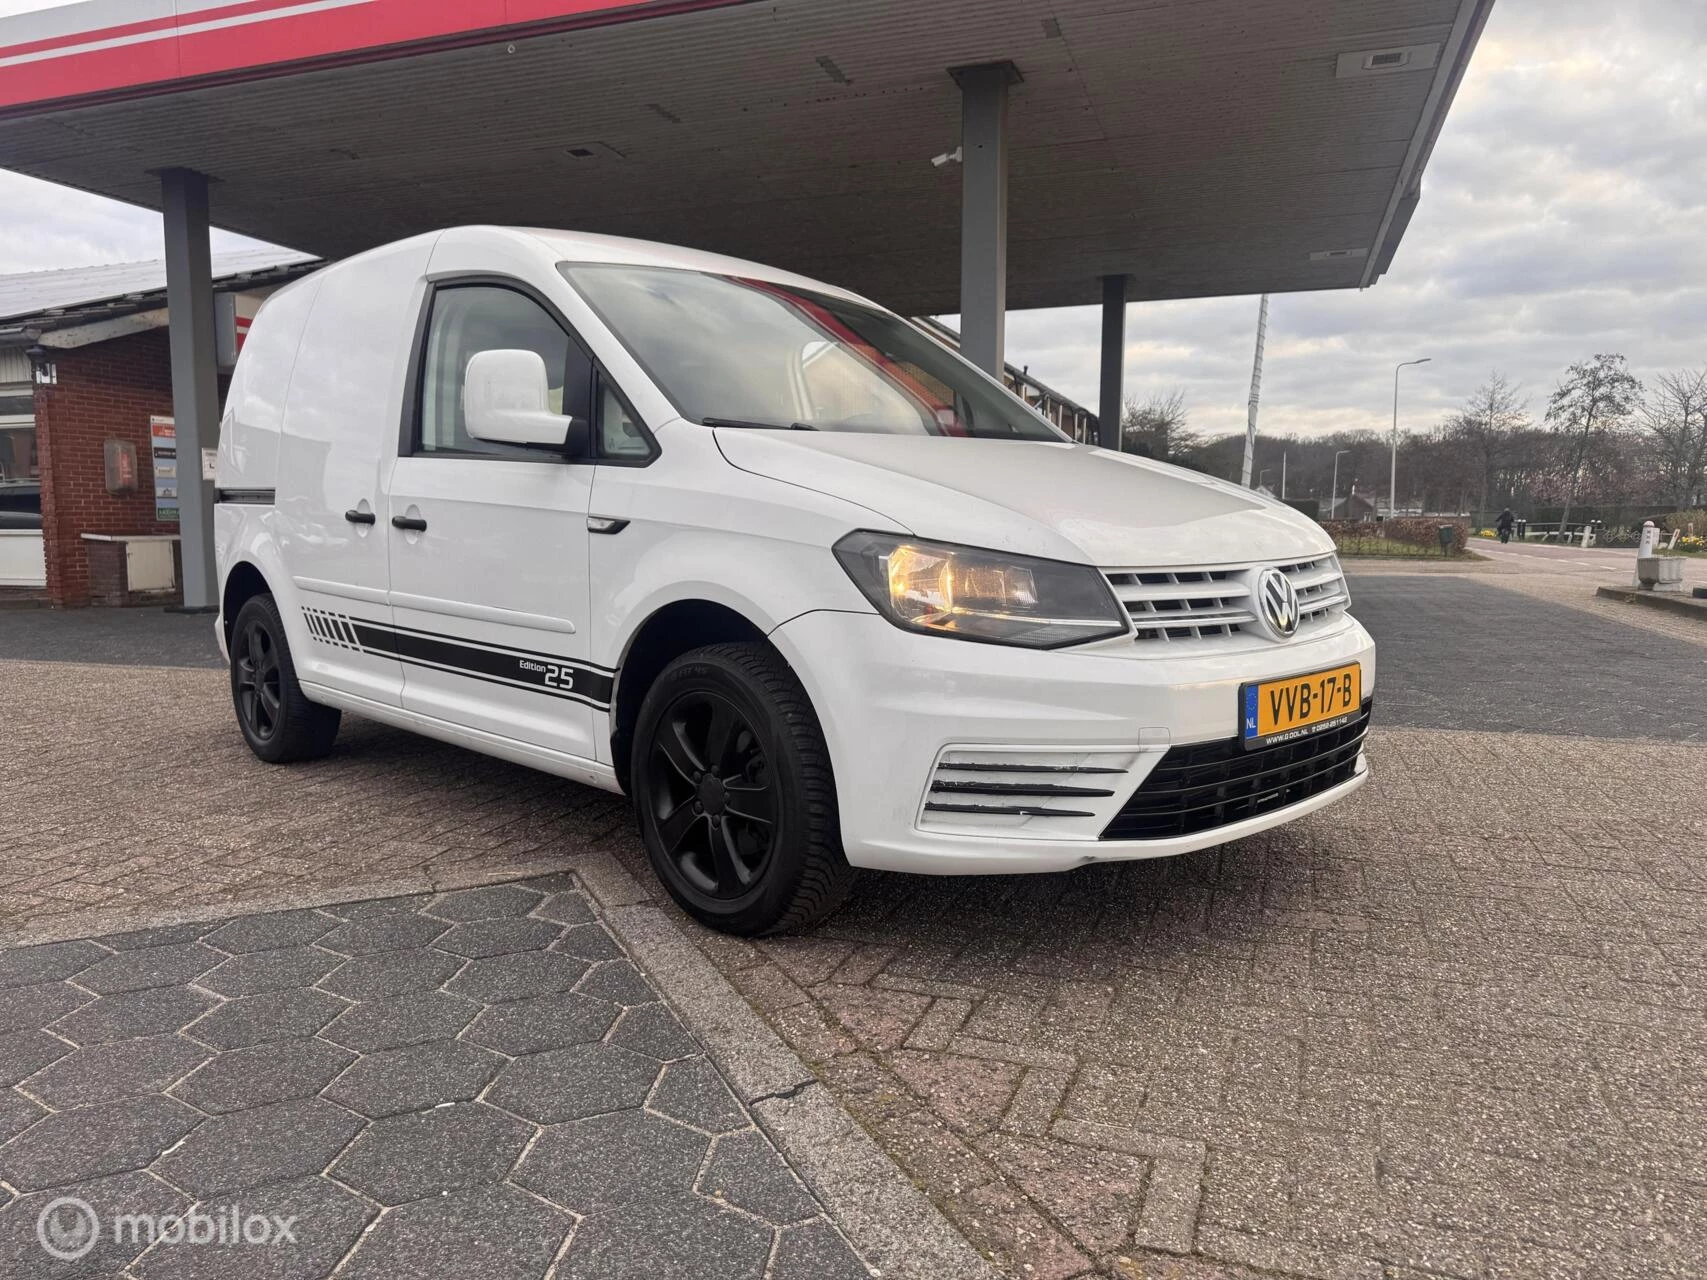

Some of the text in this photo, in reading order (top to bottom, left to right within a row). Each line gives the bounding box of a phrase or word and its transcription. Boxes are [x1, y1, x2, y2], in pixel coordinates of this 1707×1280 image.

[519, 660, 574, 689] Edition 25
[1270, 673, 1352, 726] VVB-17-B
[1246, 717, 1257, 730] NL
